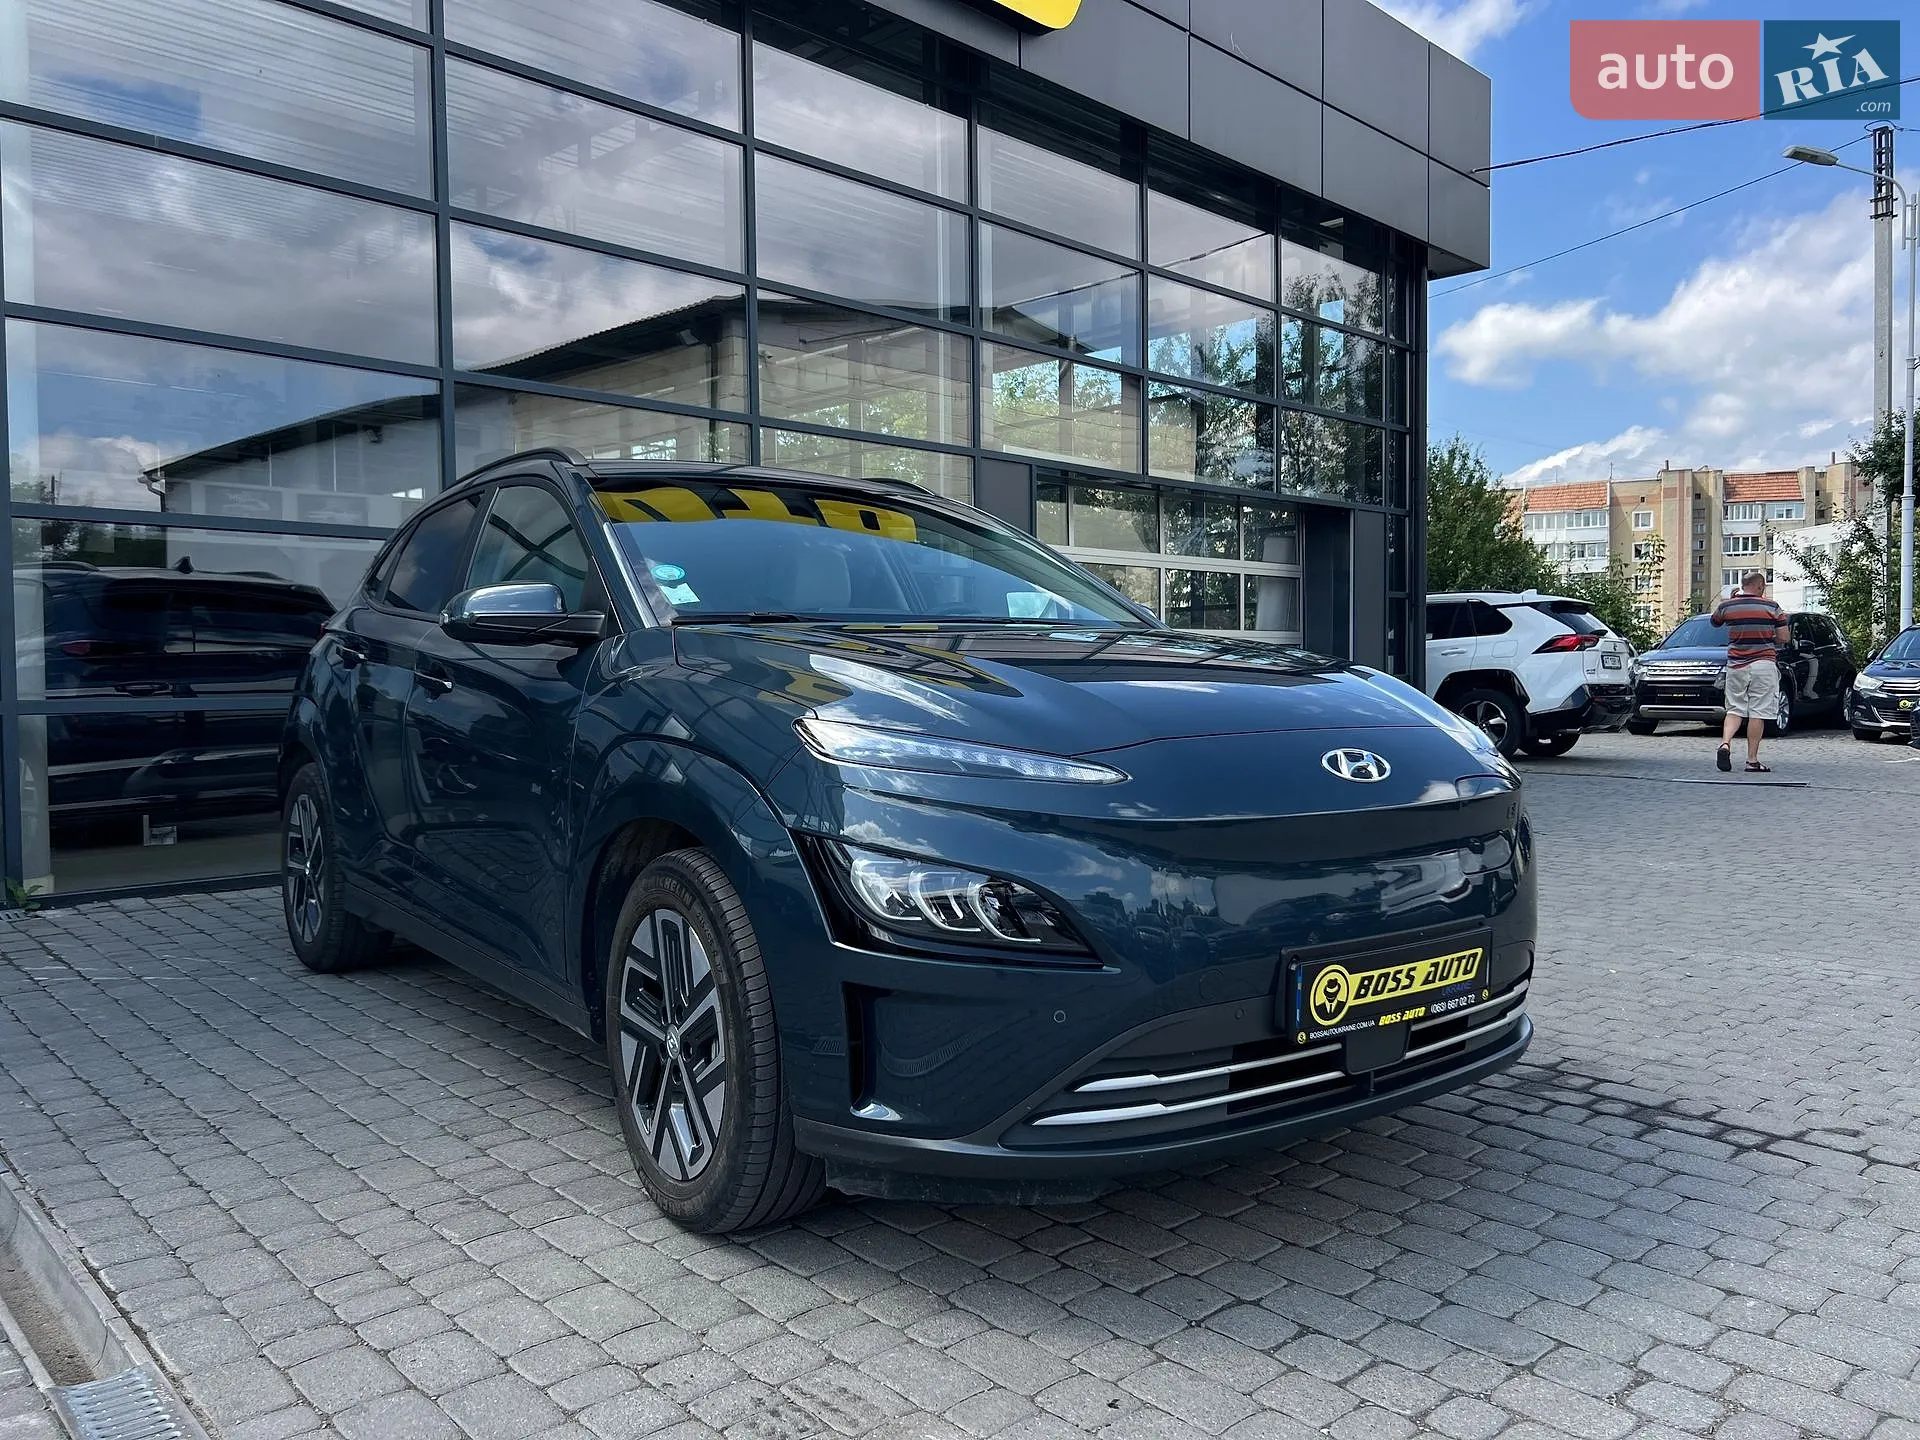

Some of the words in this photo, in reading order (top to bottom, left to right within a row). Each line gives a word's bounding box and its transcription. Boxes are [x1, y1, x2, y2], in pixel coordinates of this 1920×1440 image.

[1353, 966, 1417, 1001] BOSS
[1420, 952, 1479, 987] AUTO
[1378, 1012, 1402, 1026] BOSS
[1402, 1006, 1426, 1021] AUTO
